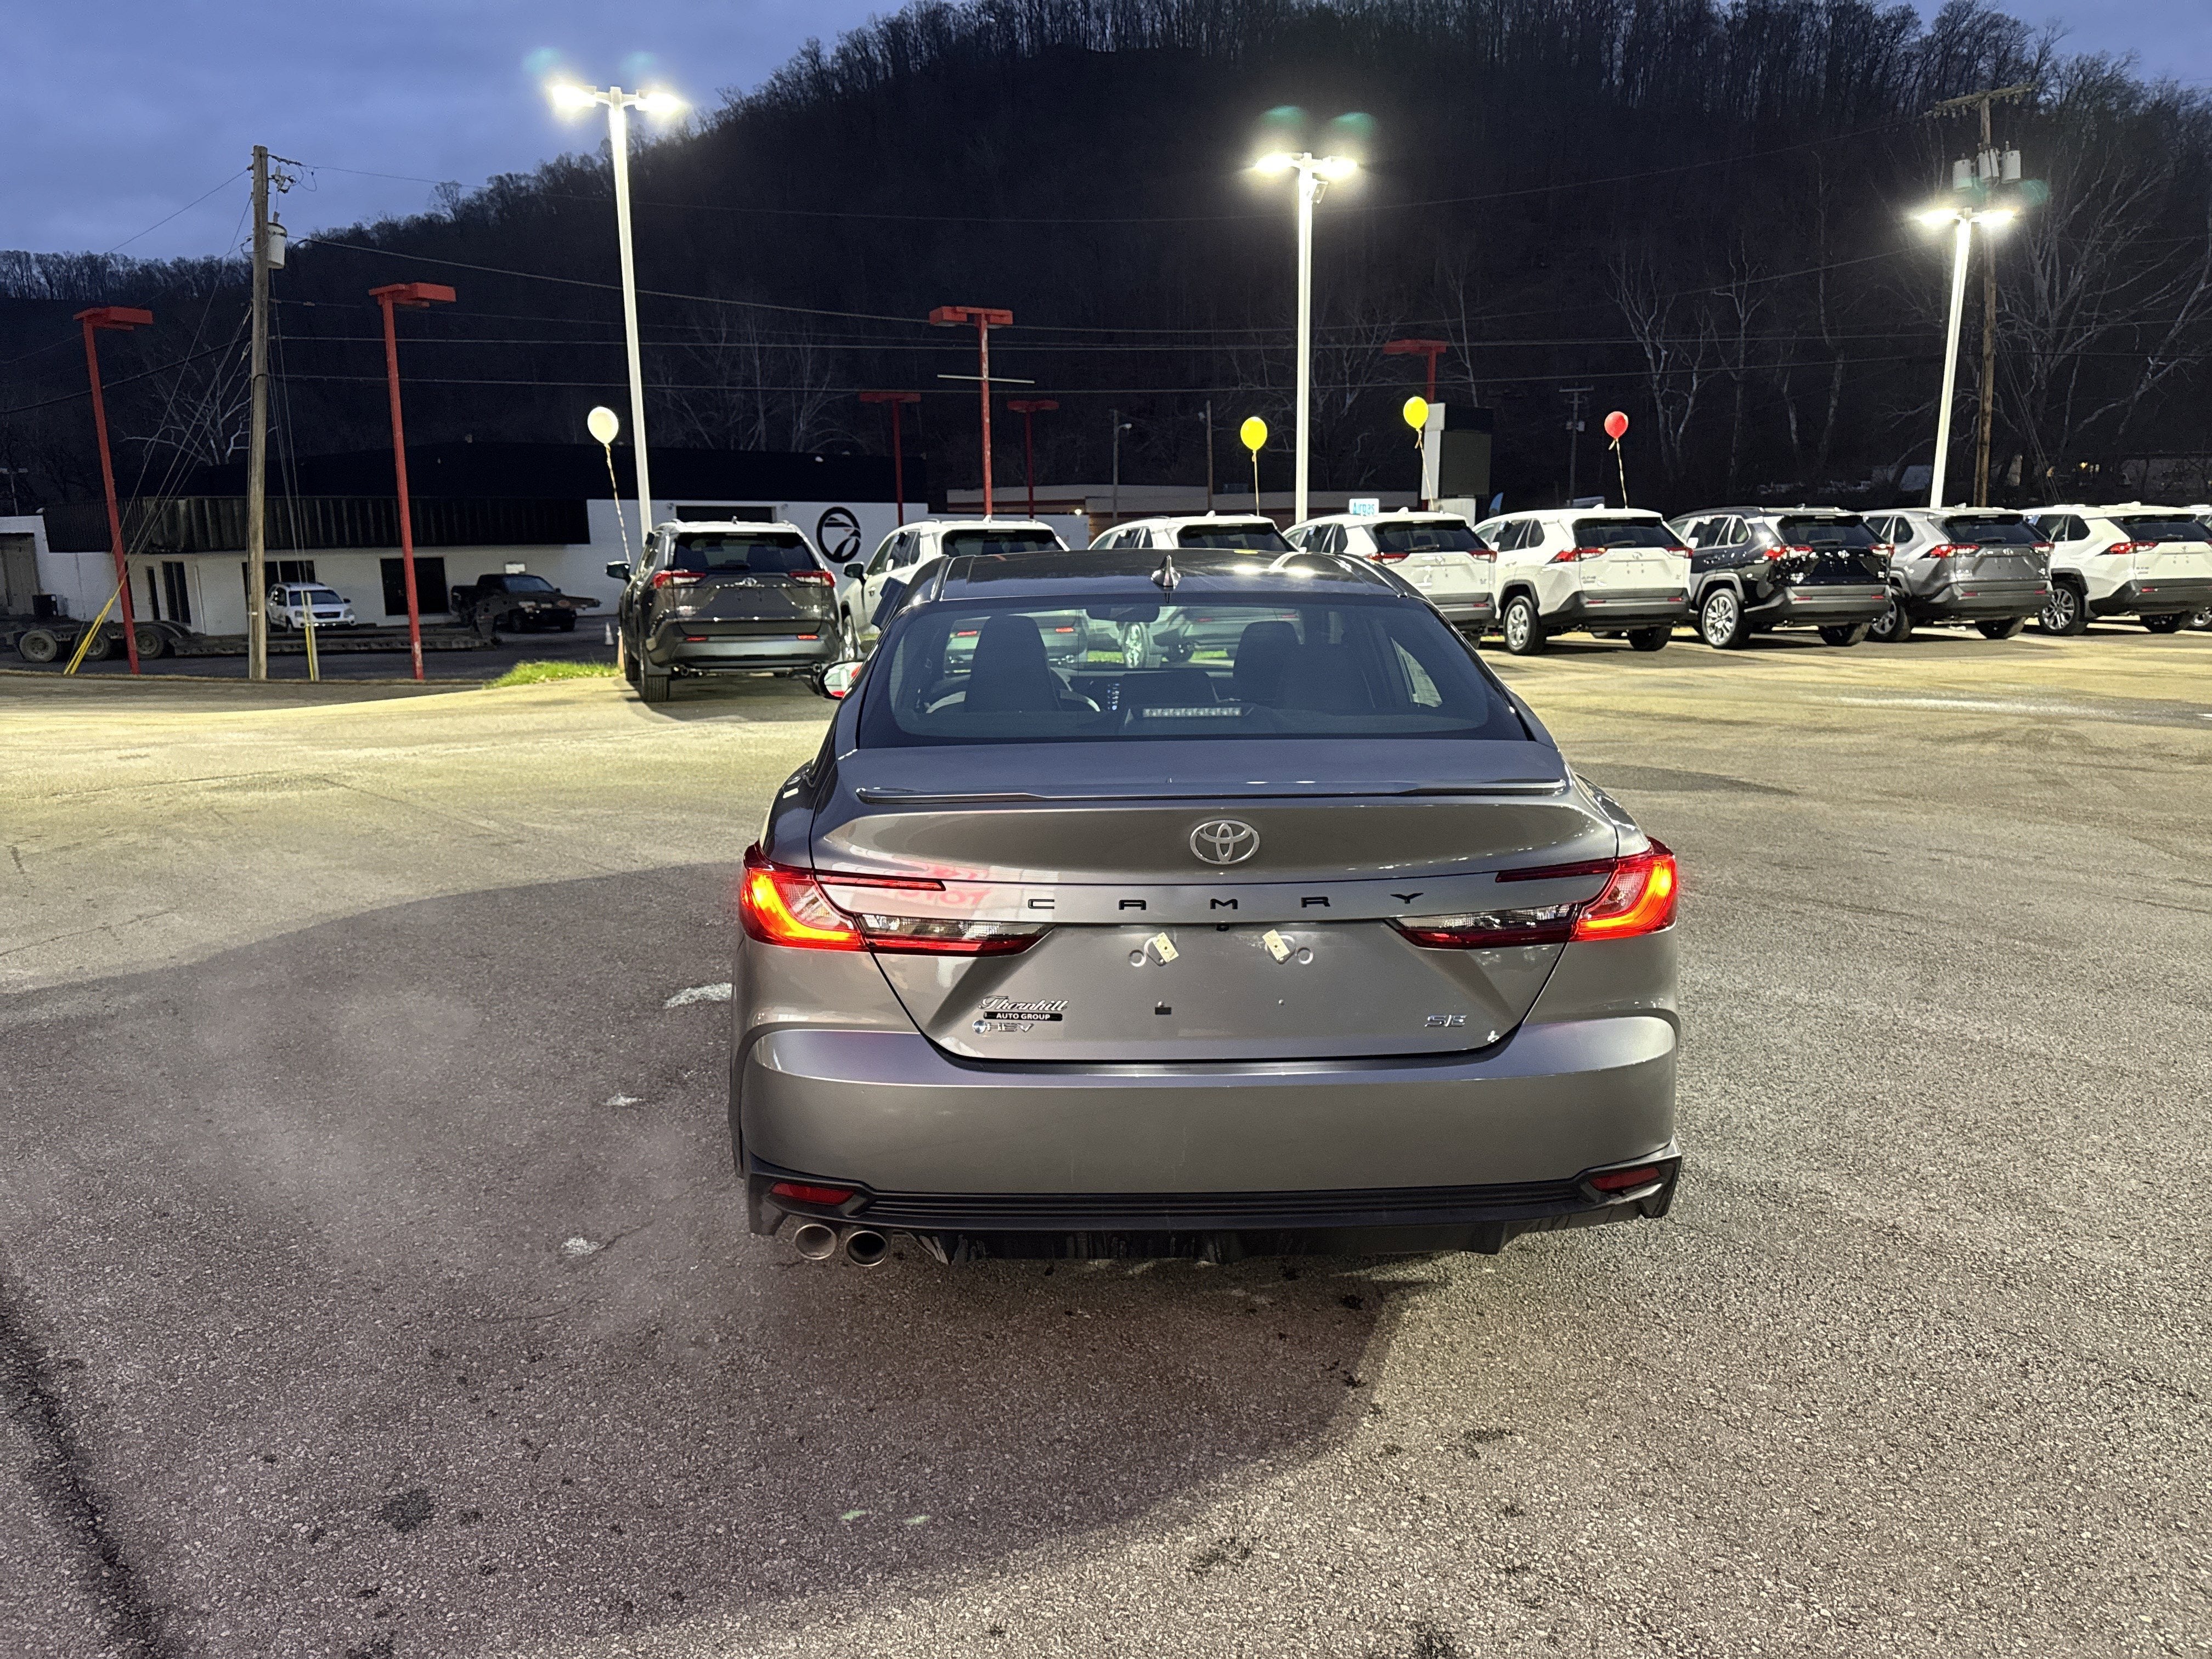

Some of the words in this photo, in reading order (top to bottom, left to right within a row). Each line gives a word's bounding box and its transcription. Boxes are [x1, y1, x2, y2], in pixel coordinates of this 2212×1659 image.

[1028, 893, 1424, 911] CAMRY
[978, 995, 1069, 1012] Thornhill
[987, 1022, 1034, 1033] HEV
[1424, 1014, 1468, 1028] SE
